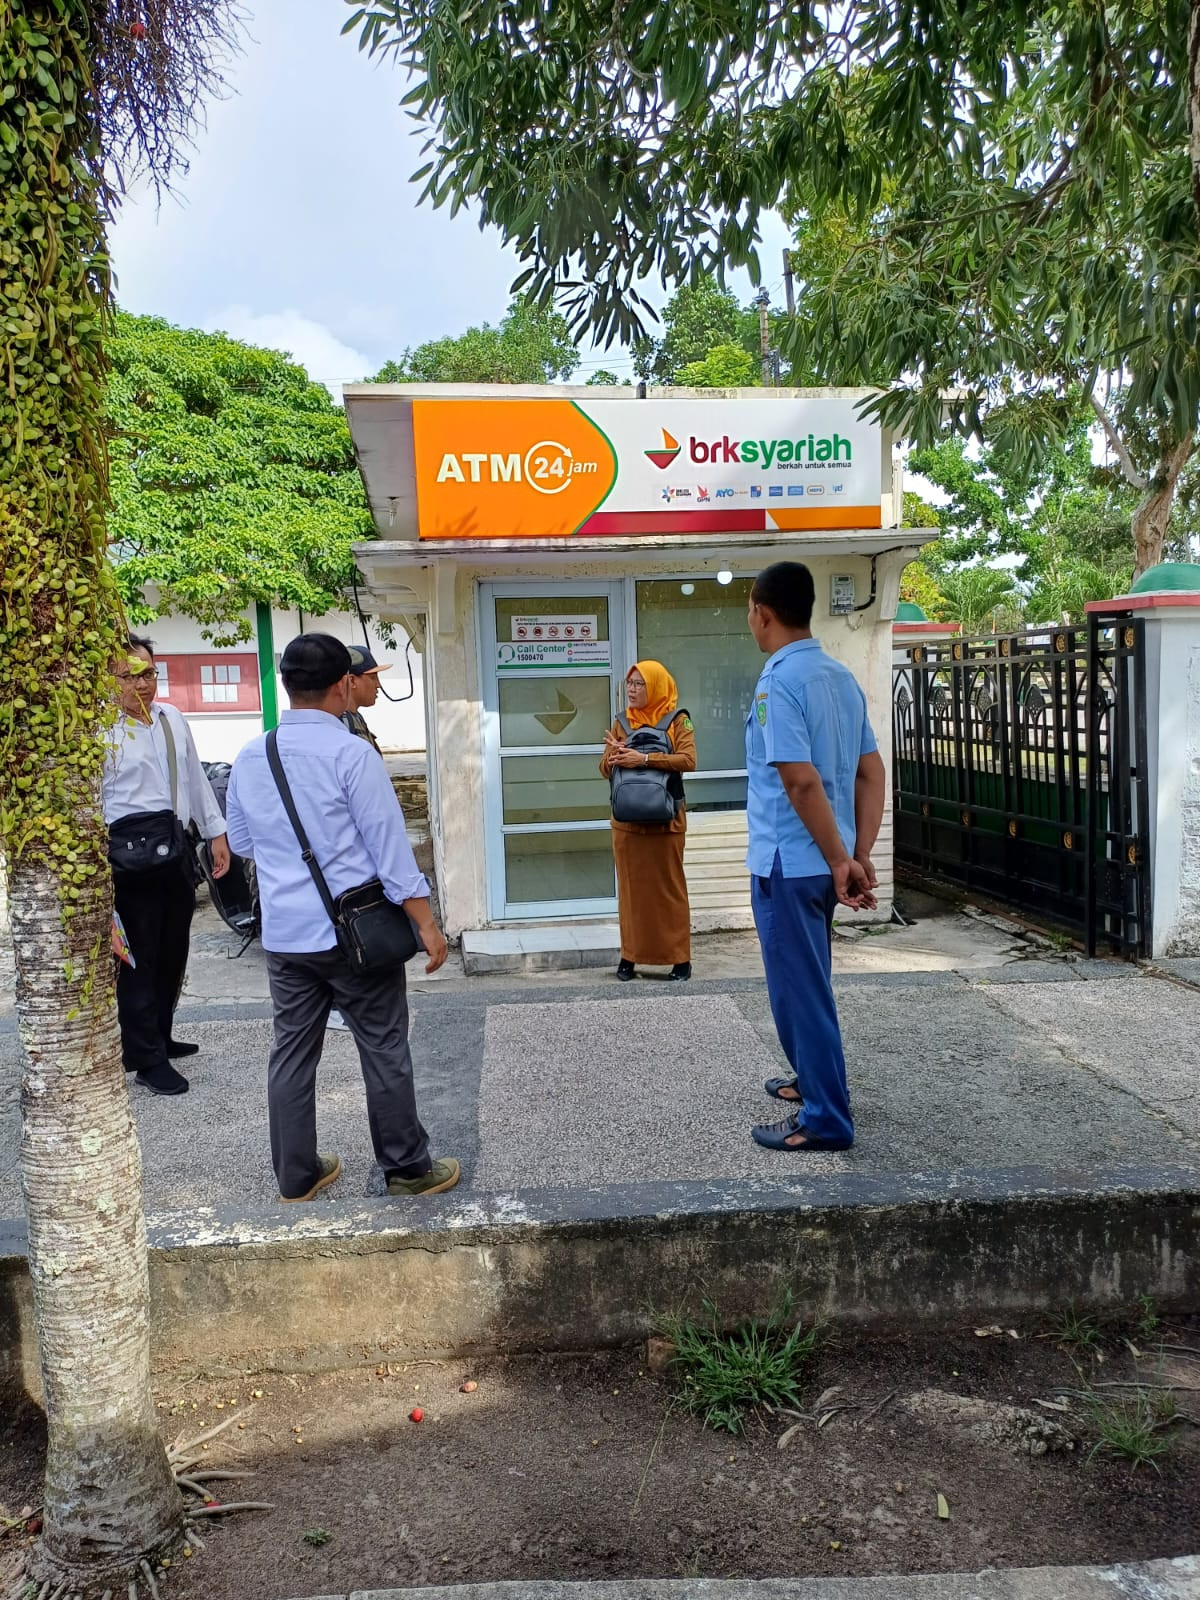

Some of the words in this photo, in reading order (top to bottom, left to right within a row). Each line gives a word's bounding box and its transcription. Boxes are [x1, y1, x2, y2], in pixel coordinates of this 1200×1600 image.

[689, 434, 852, 470] brksyariah
[436, 453, 522, 483] ATM
[534, 457, 564, 479] 24
[567, 459, 598, 477] jam
[777, 462, 803, 470] berkah
[804, 461, 826, 469] untuk
[827, 461, 852, 469] semua
[715, 488, 735, 498] AYO
[517, 645, 534, 653] Call
[536, 645, 566, 653] Center
